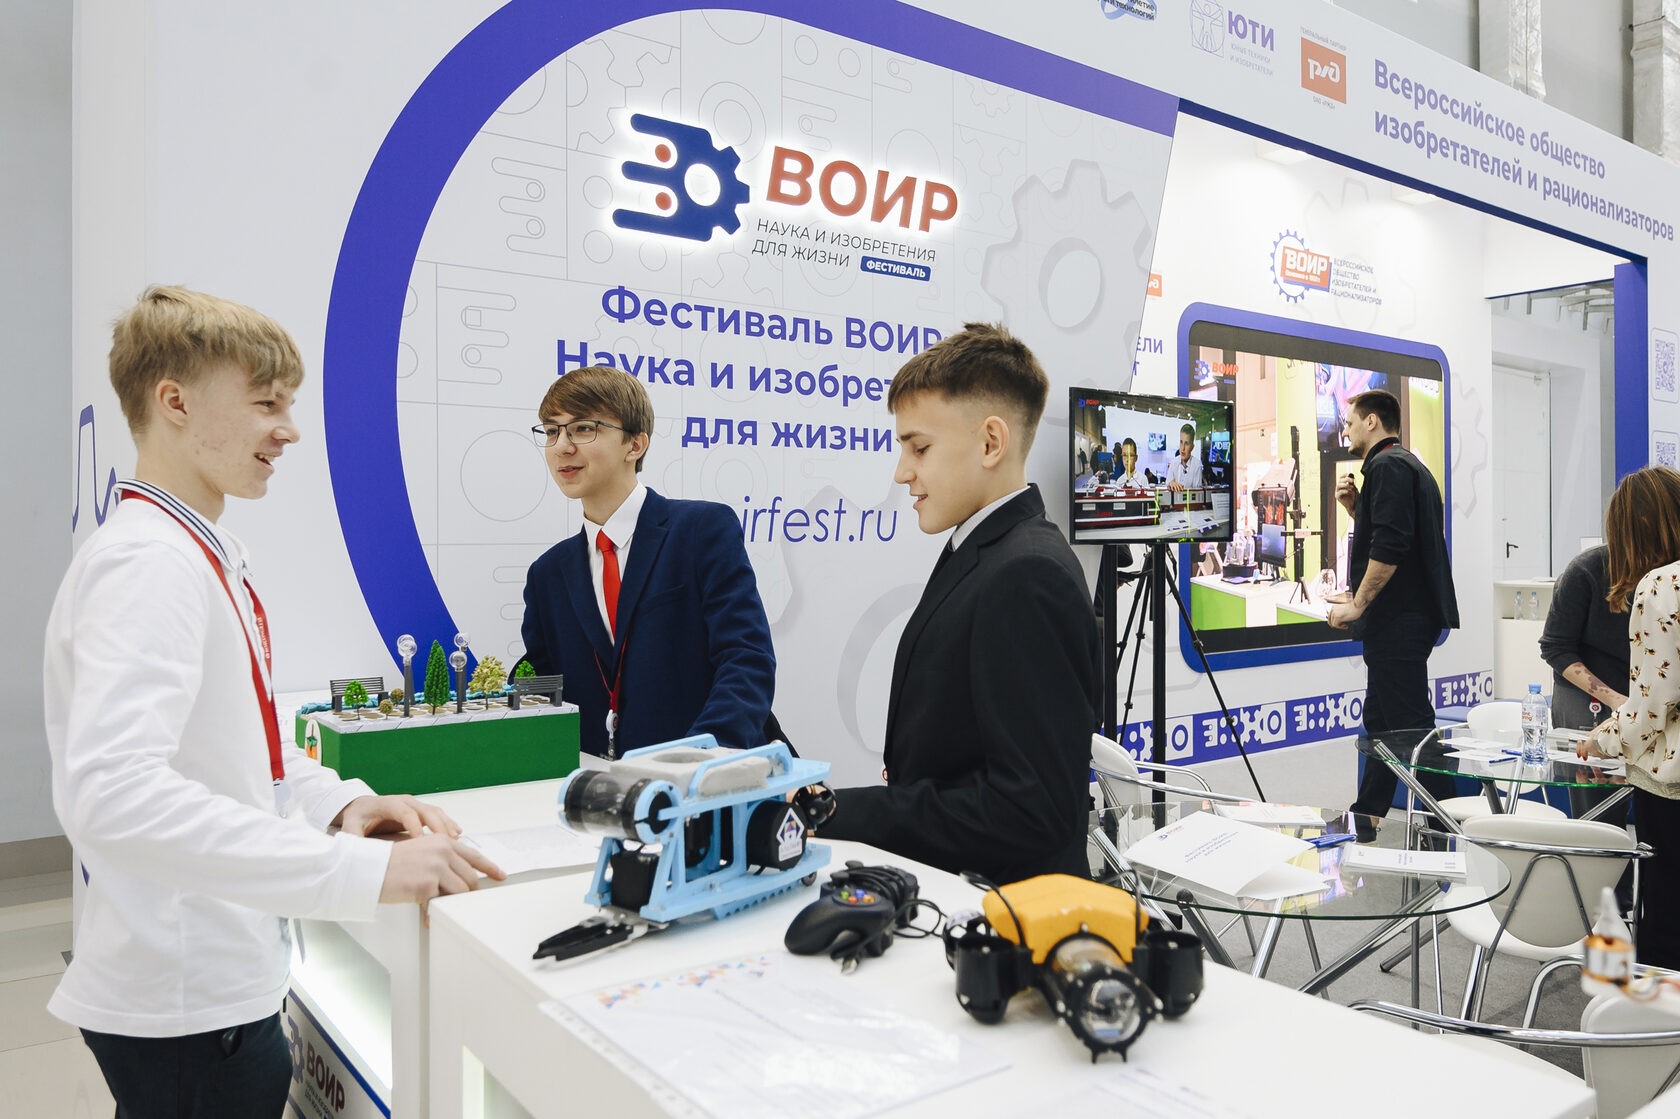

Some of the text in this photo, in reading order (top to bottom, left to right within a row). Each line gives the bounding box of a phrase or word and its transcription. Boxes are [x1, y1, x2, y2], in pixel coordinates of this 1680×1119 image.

[1228, 10, 1274, 51] ЮТИ
[1374, 59, 1605, 179] Всероссийское общество
[766, 145, 958, 233] ВОИР
[1374, 111, 1674, 242] изобретателей и рационализаторов
[751, 239, 850, 267] ДЛЯ ЖИЗНИ
[756, 218, 936, 262] НАУКА И ИЗОБРЕТЕНИЯ
[1285, 248, 1328, 275] ВОИР
[866, 259, 926, 278] ФЕСТИВАЛЬ
[601, 285, 834, 345] Фестиваль
[556, 339, 893, 407] Наука и изобре
[1212, 361, 1240, 376] ВОИР
[681, 416, 893, 453] для жизни
[742, 495, 898, 543] irfest.ru
[306, 1040, 346, 1113] ВОИР
